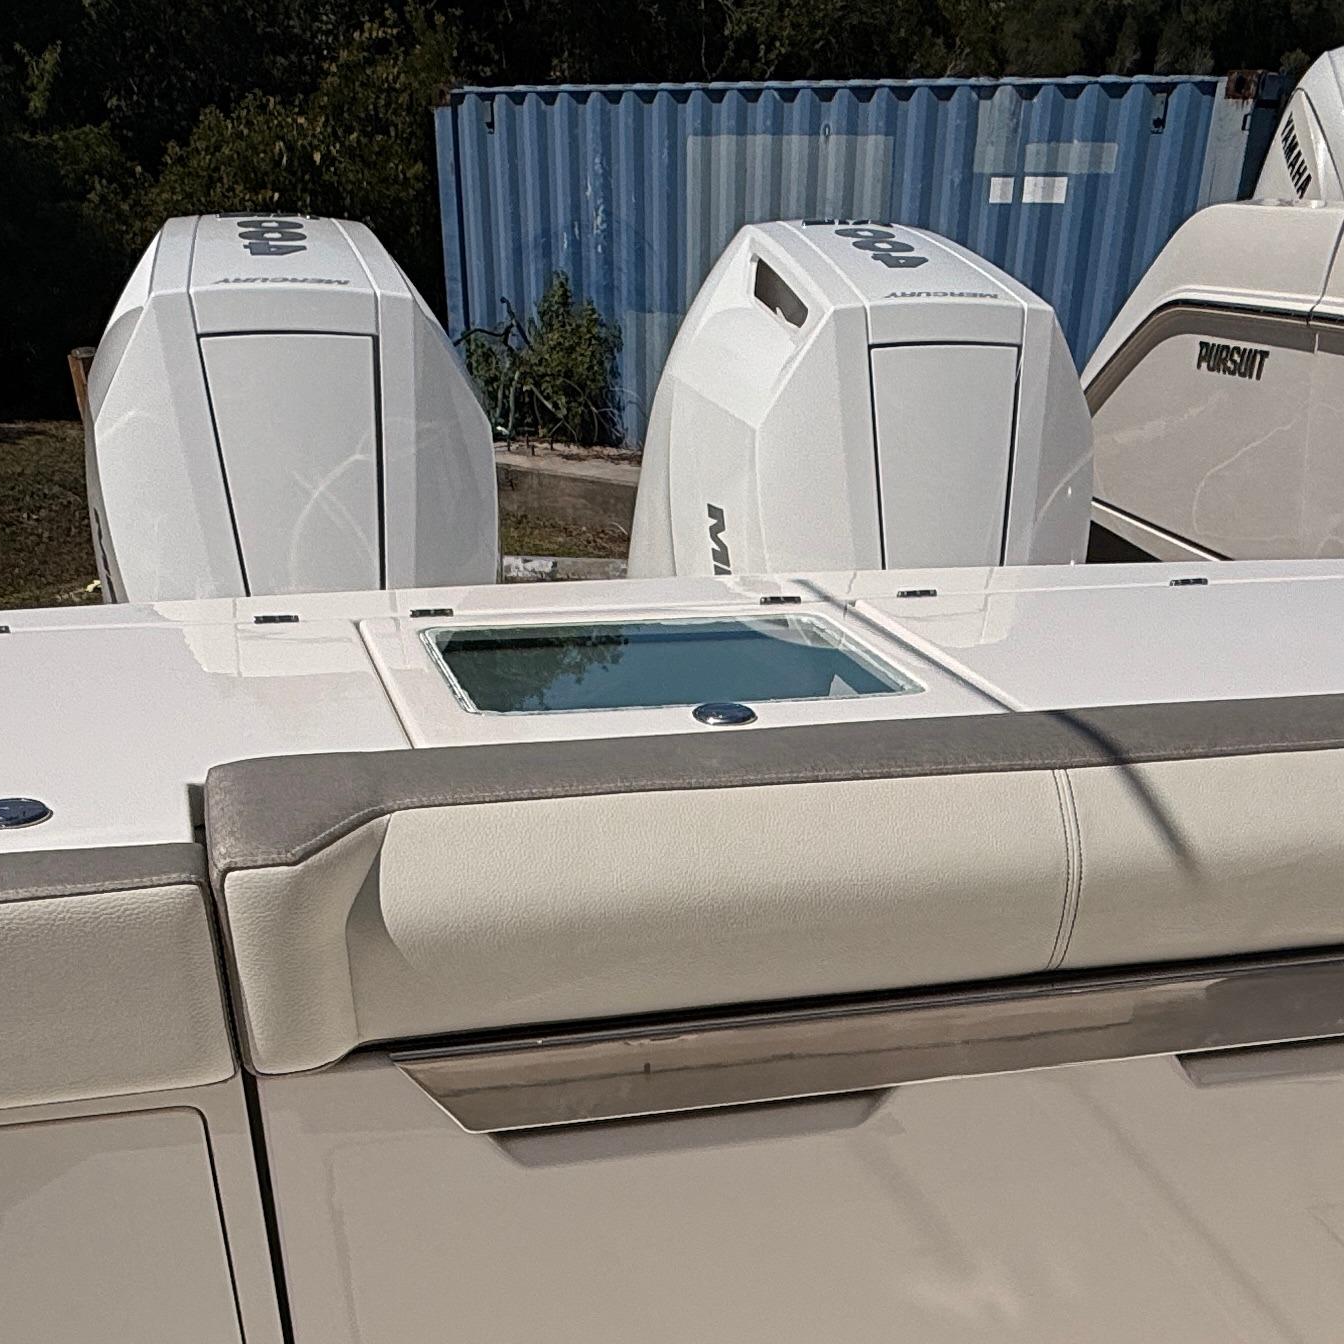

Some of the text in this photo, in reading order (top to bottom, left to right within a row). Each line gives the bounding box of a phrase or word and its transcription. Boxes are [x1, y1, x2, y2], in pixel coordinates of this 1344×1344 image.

[1281, 111, 1312, 200] YAMAHA
[236, 219, 308, 256] 400
[834, 227, 930, 269] 400
[884, 291, 999, 299] MERCURY
[1197, 341, 1270, 381] PURSUIT
